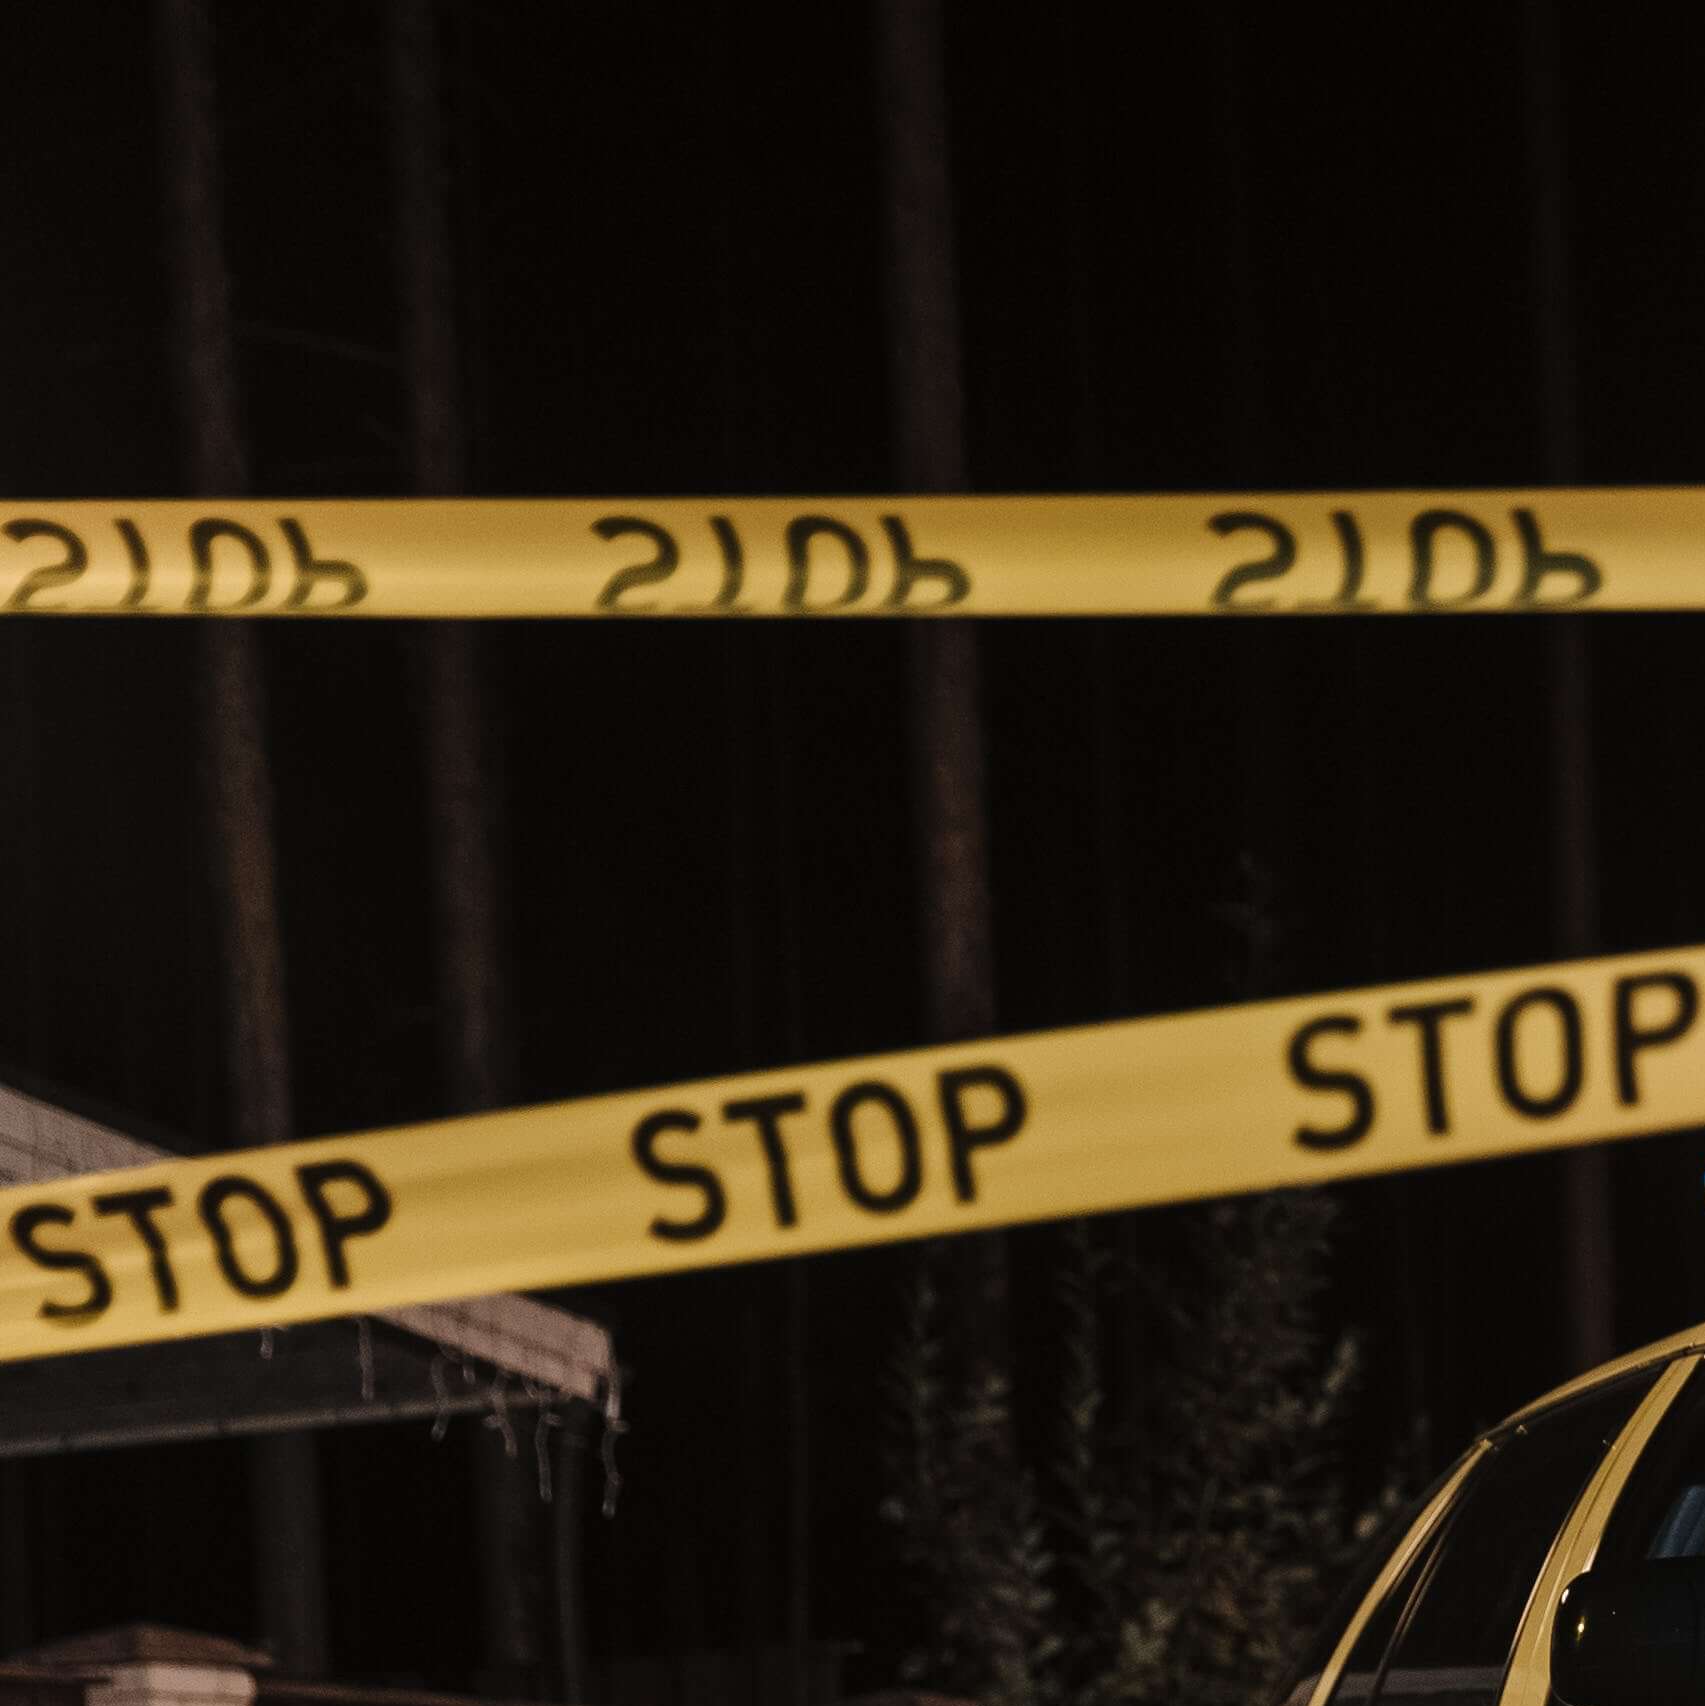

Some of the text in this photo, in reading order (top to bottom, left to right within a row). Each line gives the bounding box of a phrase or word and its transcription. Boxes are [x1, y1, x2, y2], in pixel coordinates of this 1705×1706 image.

[8, 1158, 396, 1326] STOP
[628, 1063, 1032, 1246] STOP
[1286, 970, 1702, 1154] STOP
